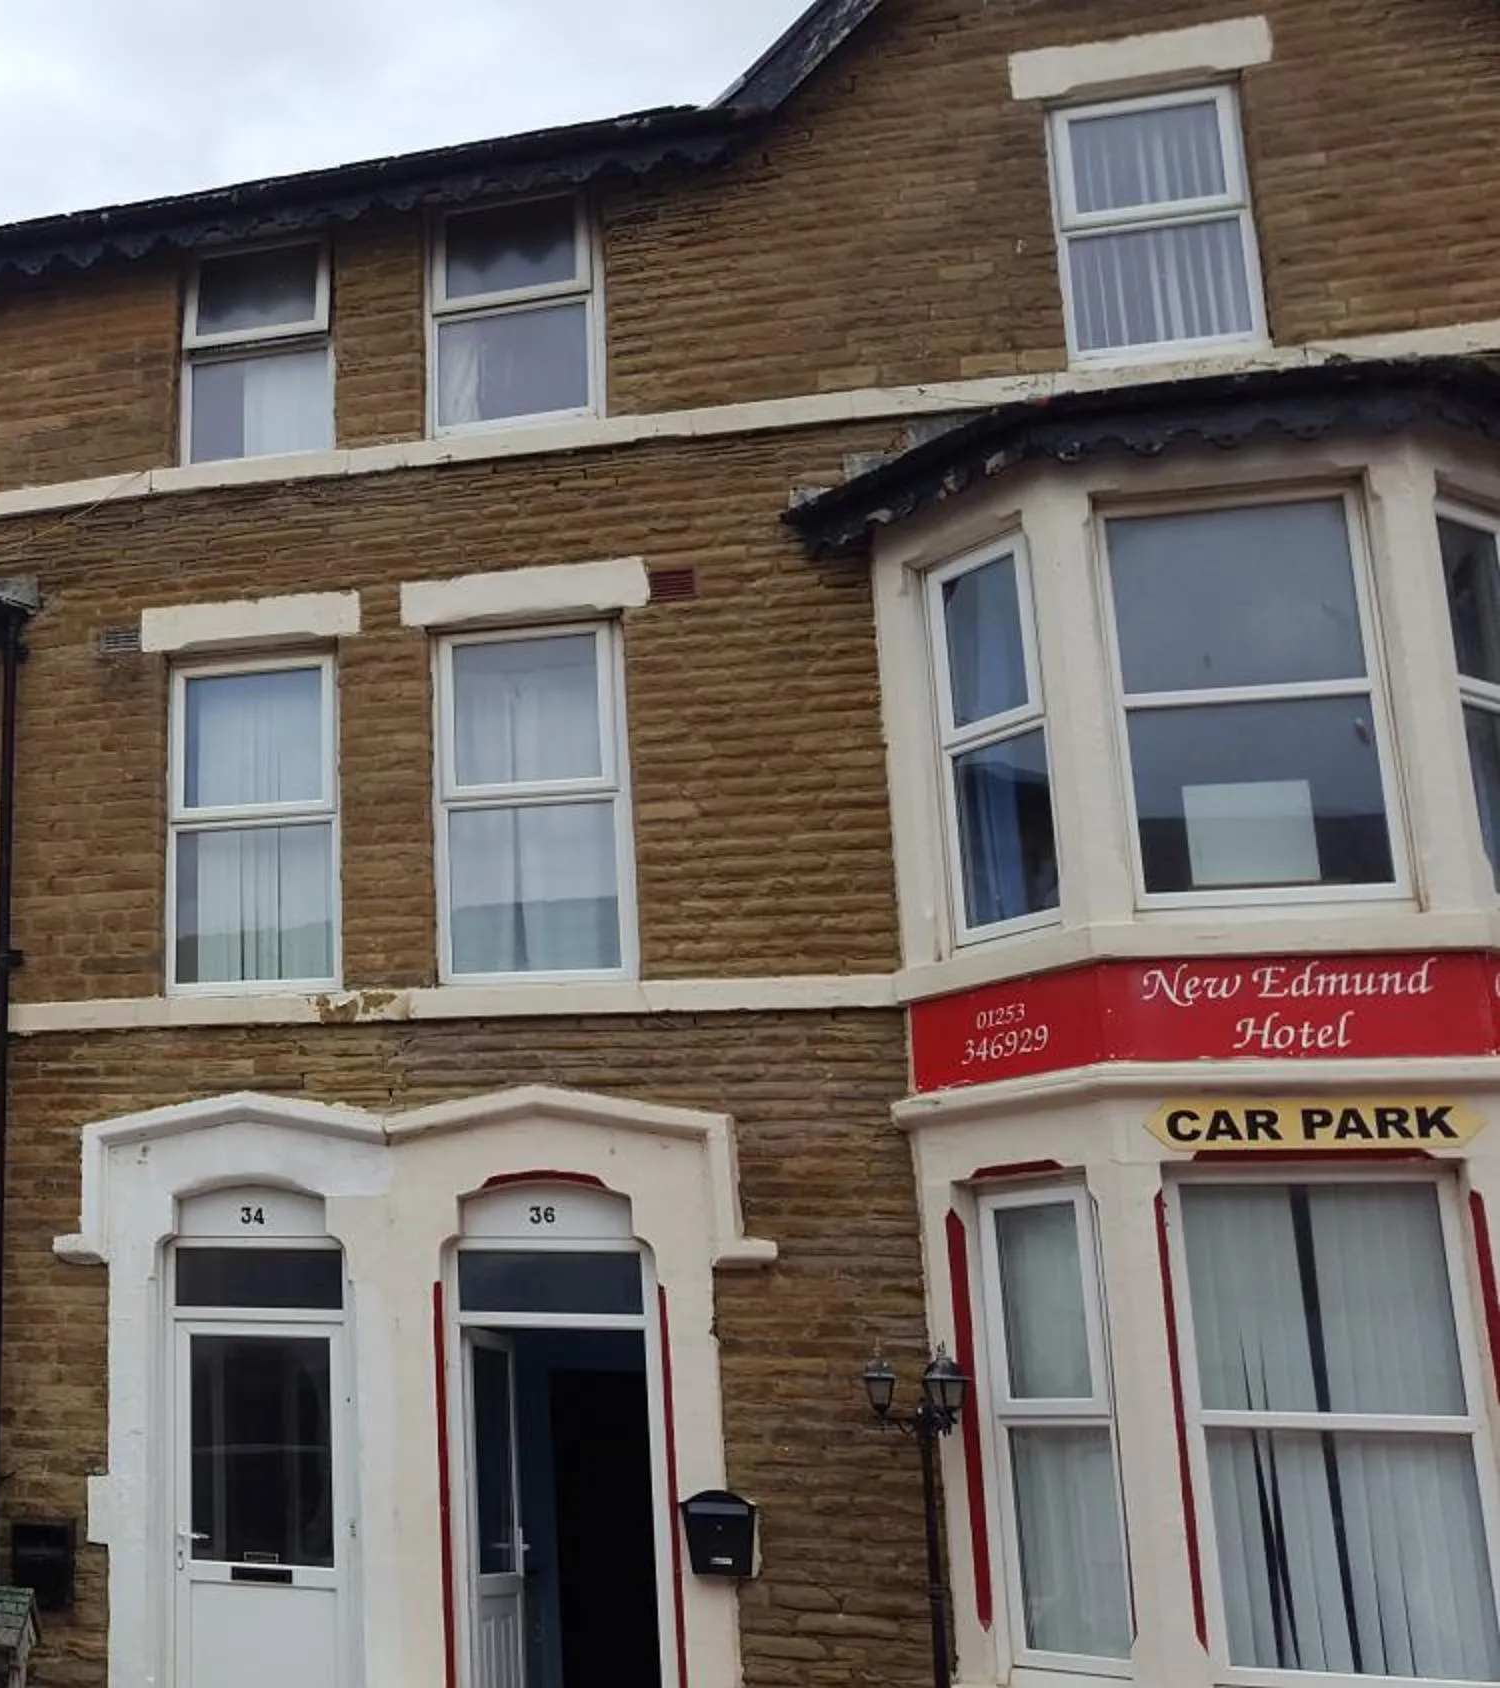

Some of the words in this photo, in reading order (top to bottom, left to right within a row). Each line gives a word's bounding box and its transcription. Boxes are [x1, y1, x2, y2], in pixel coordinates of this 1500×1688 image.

[1141, 962, 1240, 1006] New
[1251, 957, 1436, 998] Edmund
[975, 1002, 1026, 1030] 01253
[1233, 1010, 1355, 1050] Hotel
[960, 1024, 1049, 1065] 346929
[1166, 1109, 1281, 1143] CAR
[1302, 1106, 1461, 1141] PARK
[240, 1207, 265, 1225] 34
[529, 1206, 556, 1225] 36
